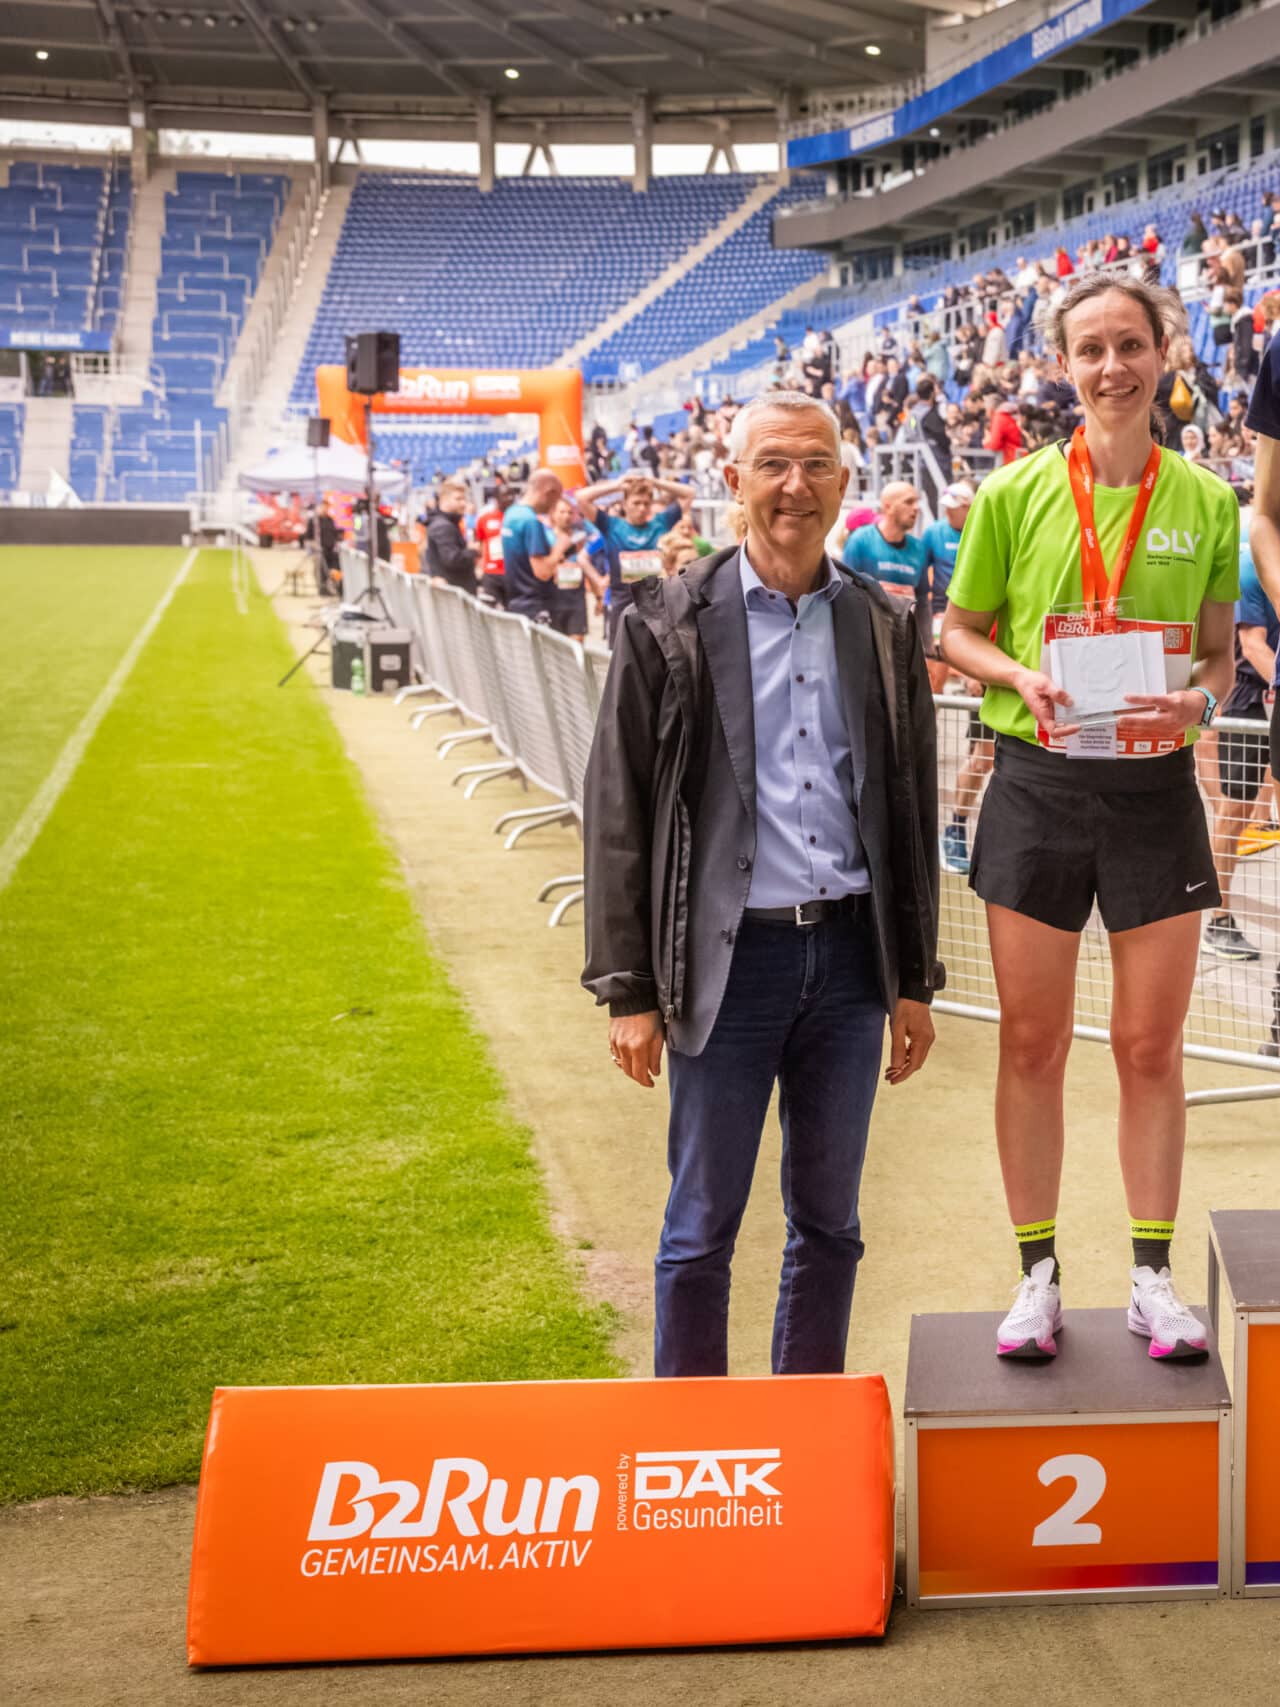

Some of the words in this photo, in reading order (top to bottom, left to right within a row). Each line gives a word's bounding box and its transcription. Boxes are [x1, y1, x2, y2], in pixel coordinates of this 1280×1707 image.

[1058, 621, 1090, 636] B2Ru
[616, 1453, 631, 1469] by
[635, 1448, 782, 1500] DAK
[307, 1457, 600, 1541] B2Run
[616, 1473, 629, 1531] powered
[633, 1498, 782, 1530] Gesundheit
[1032, 1454, 1107, 1546] 2
